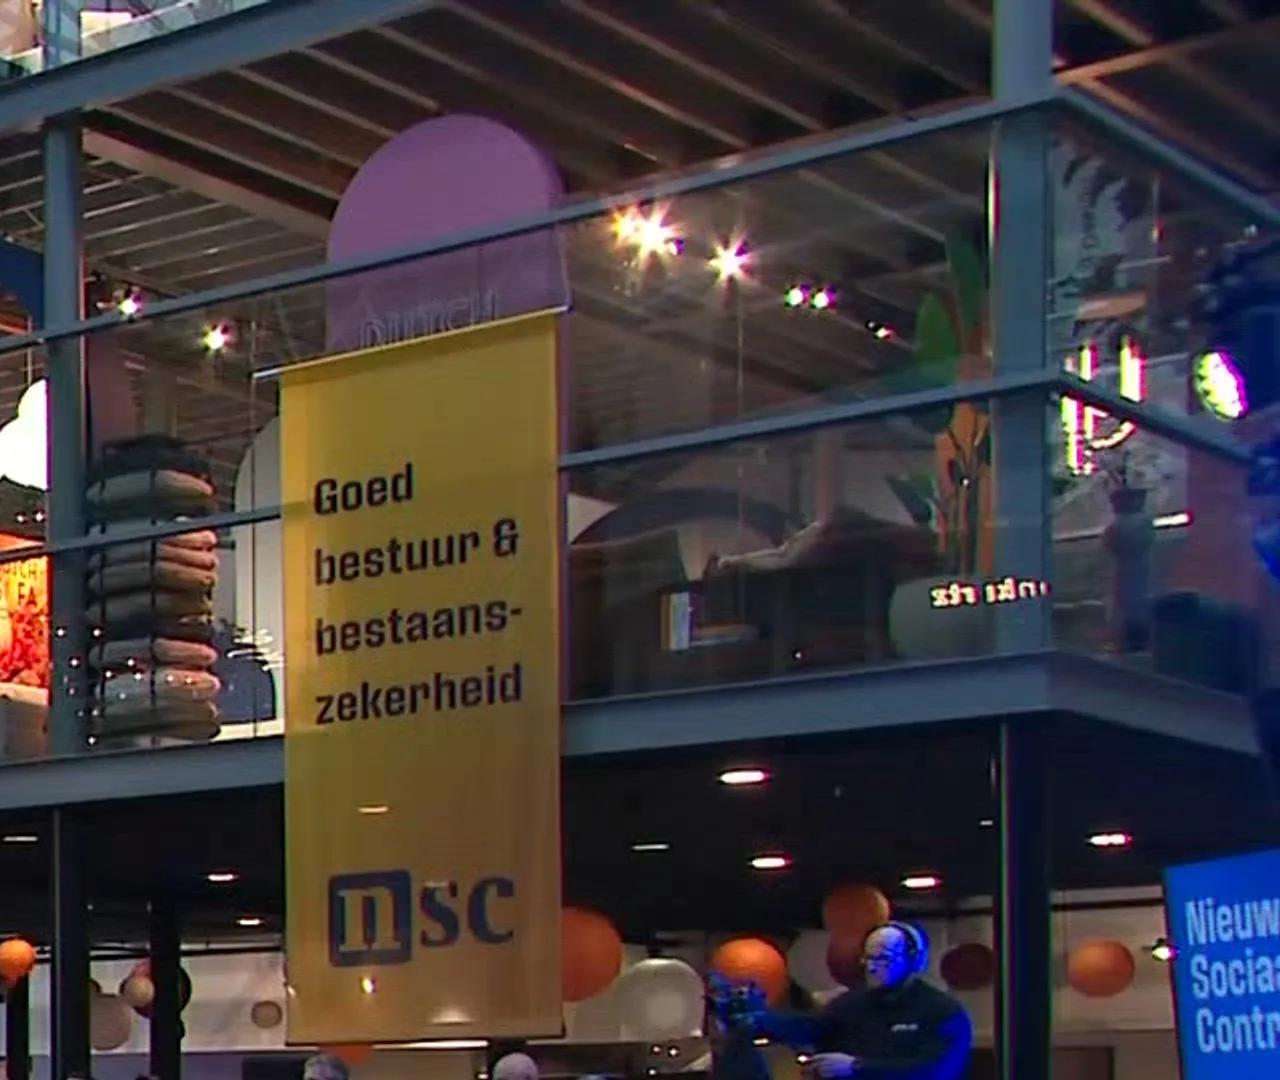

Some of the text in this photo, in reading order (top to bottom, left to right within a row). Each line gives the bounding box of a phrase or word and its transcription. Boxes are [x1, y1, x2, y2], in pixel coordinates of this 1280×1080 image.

[314, 462, 413, 516] Goed
[315, 518, 519, 586] bestuur &
[315, 600, 522, 655] bestaans-
[315, 663, 522, 724] zekerheid
[1185, 897, 1280, 946] Nieuw
